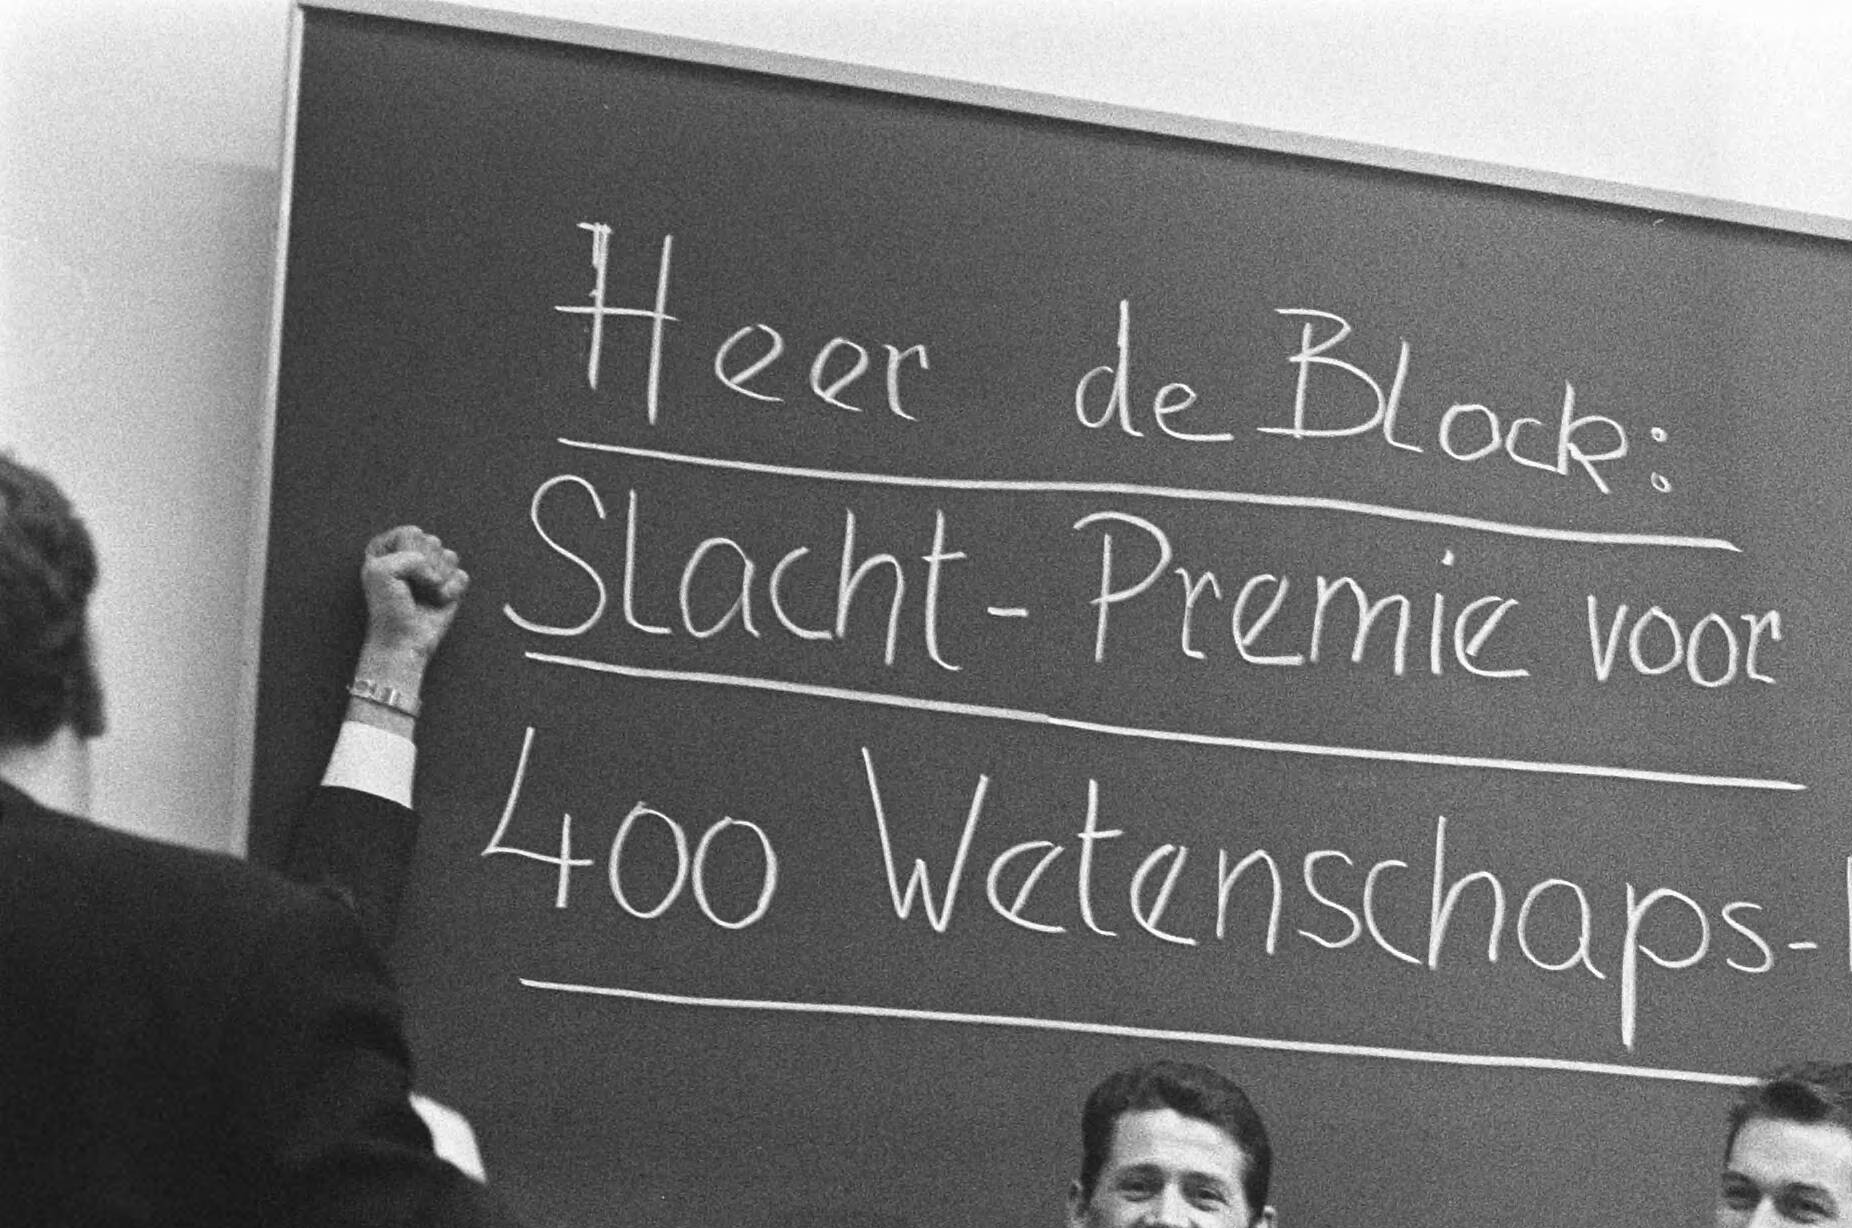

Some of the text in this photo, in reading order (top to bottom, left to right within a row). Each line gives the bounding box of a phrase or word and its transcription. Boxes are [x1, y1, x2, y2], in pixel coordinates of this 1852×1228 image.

[554, 220, 1676, 497] Heer de Block:
[1585, 591, 1786, 690] voor
[481, 725, 779, 931] 400
